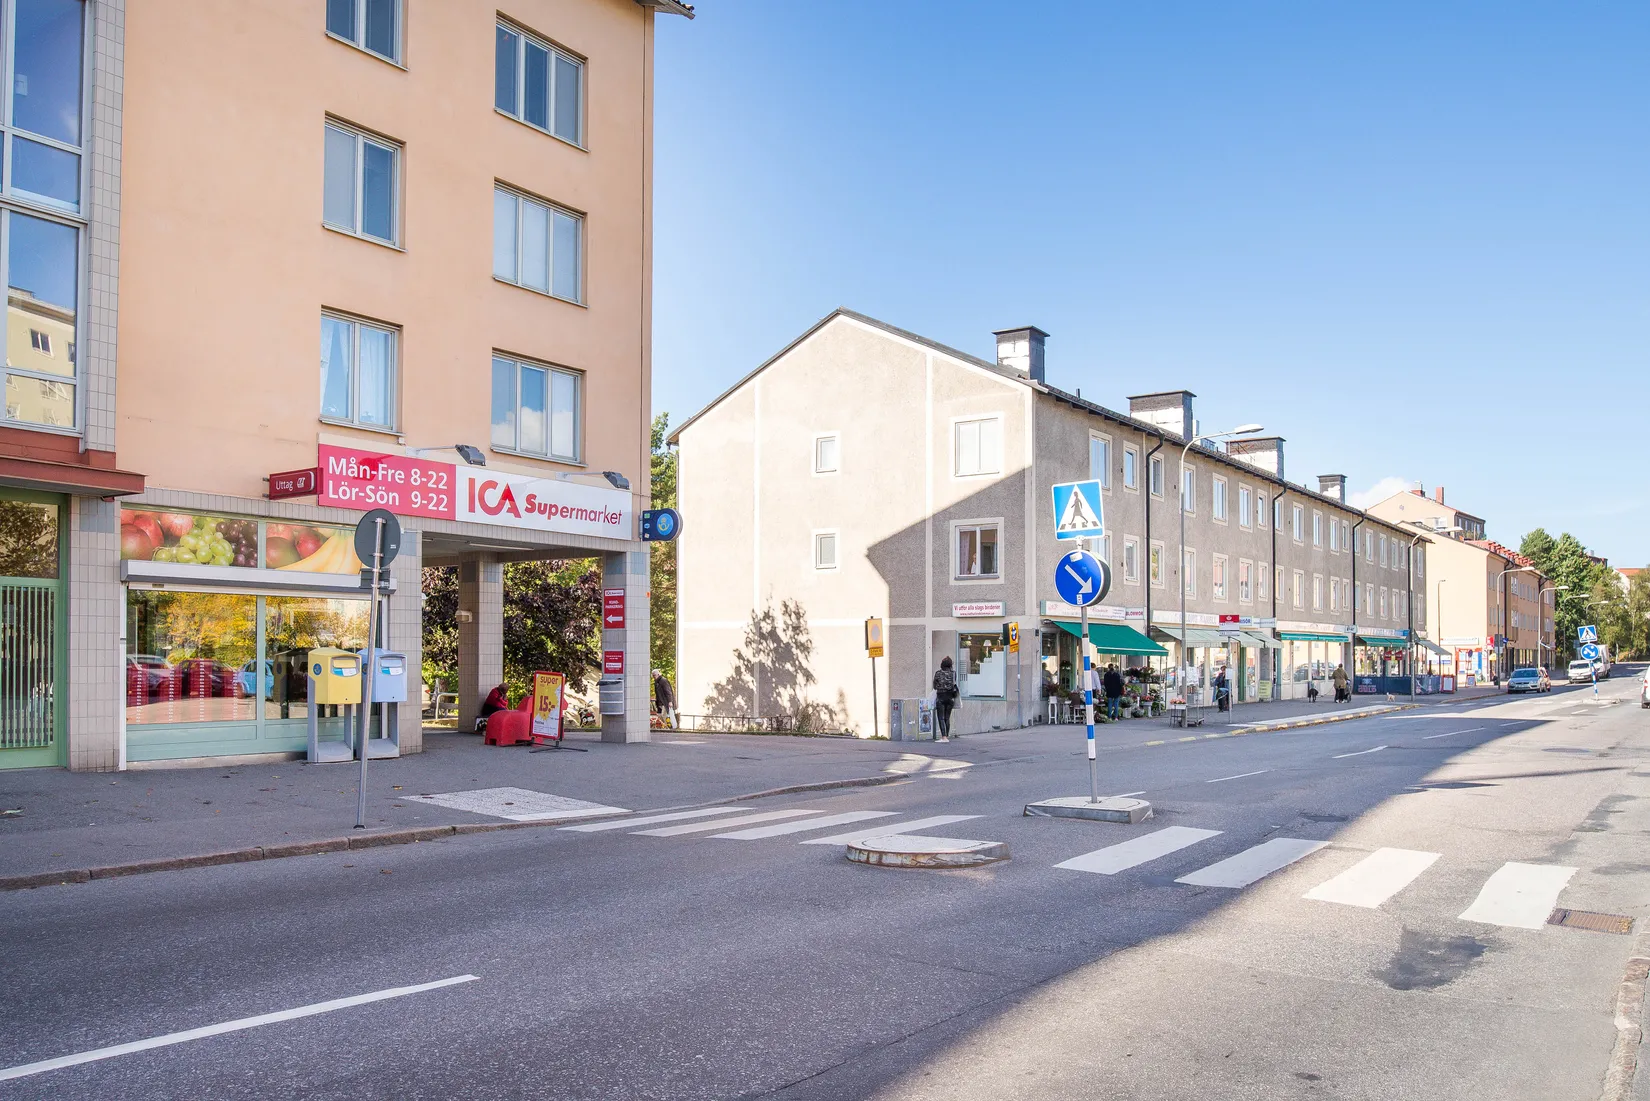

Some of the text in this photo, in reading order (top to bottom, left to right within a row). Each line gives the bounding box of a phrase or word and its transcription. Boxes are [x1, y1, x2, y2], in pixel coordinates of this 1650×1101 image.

[275, 479, 293, 491] Uttag
[329, 456, 448, 490] Mån-Fre 8-22
[328, 480, 448, 512] Lör-Sön 9-22
[468, 477, 623, 525] ICA Supermarket
[540, 676, 558, 686] super
